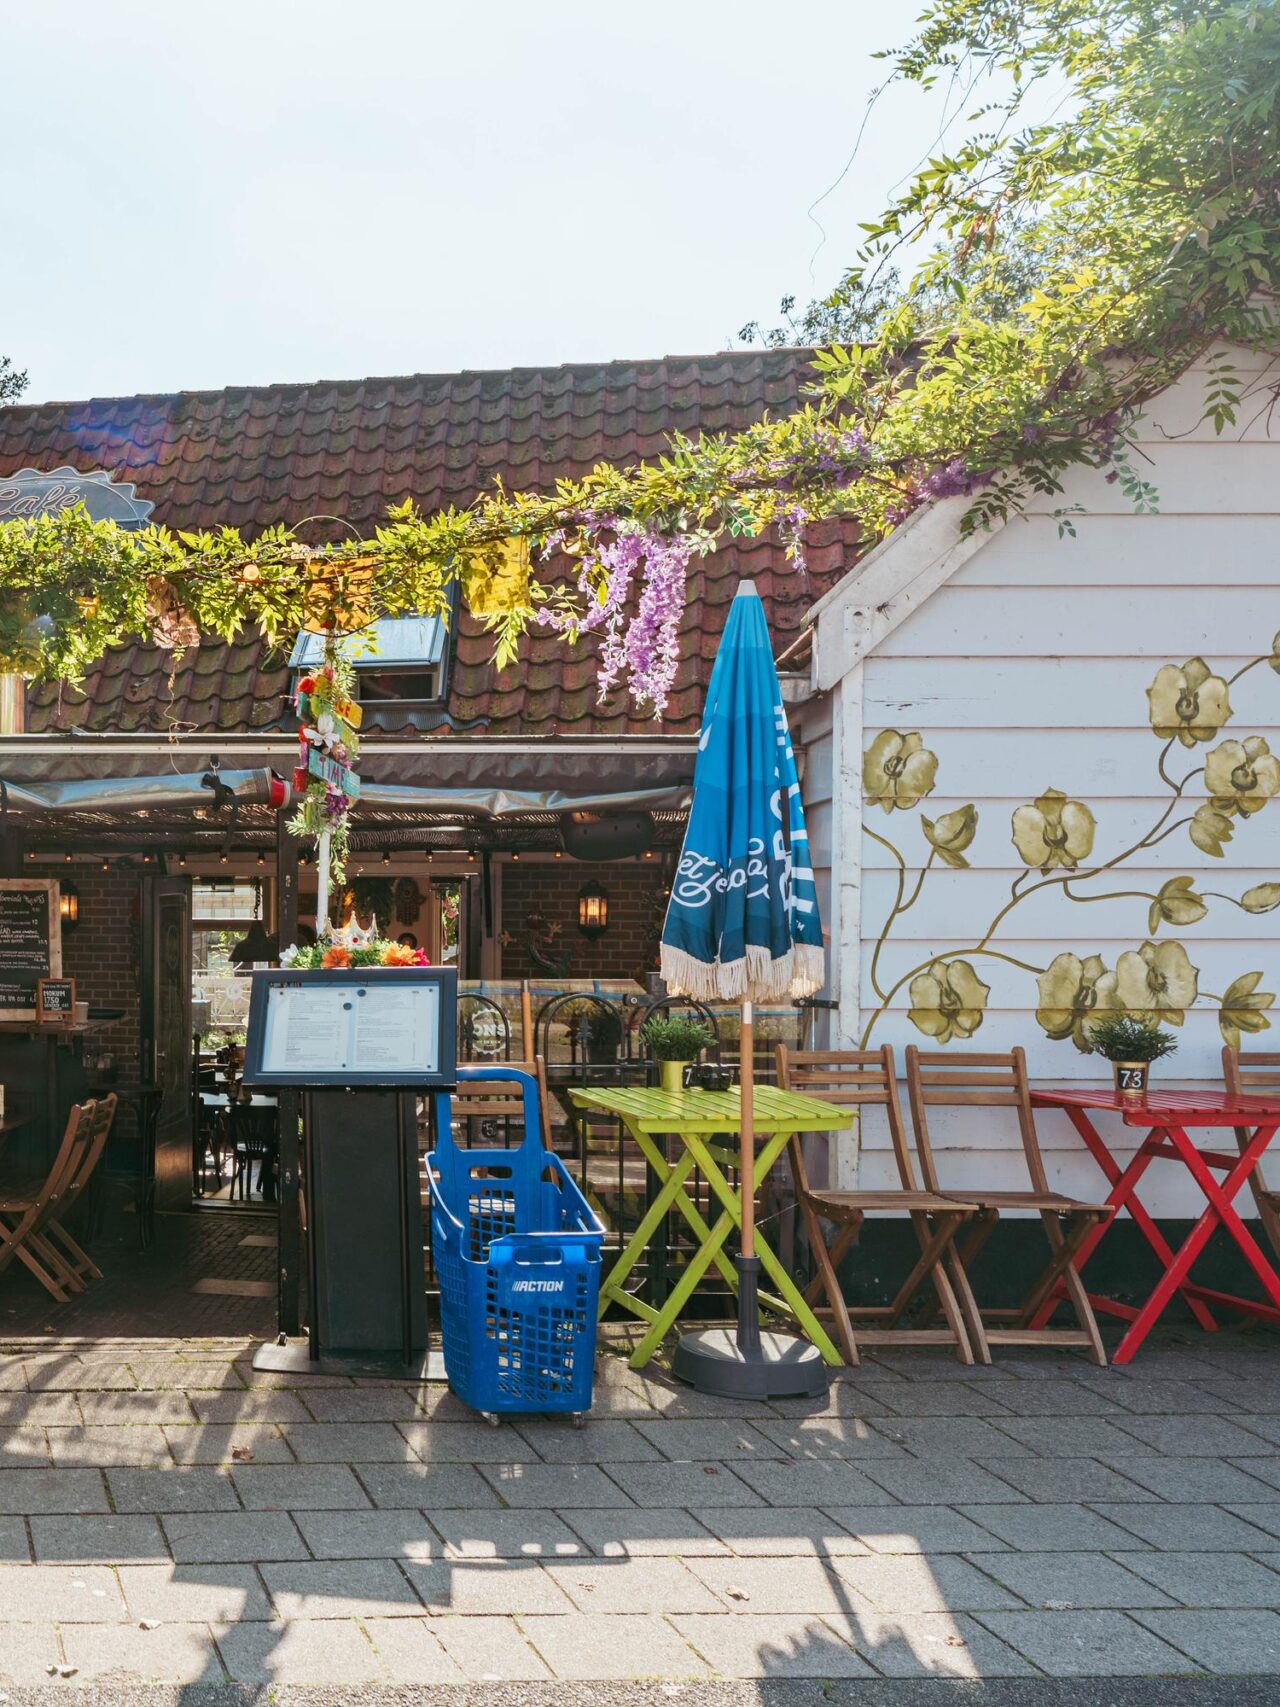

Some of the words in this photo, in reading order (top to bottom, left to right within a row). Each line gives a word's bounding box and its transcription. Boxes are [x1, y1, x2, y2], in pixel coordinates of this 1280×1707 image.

[44, 997, 60, 1005] 1750
[1120, 1070, 1142, 1088] 73
[519, 1281, 563, 1291] ACTION
